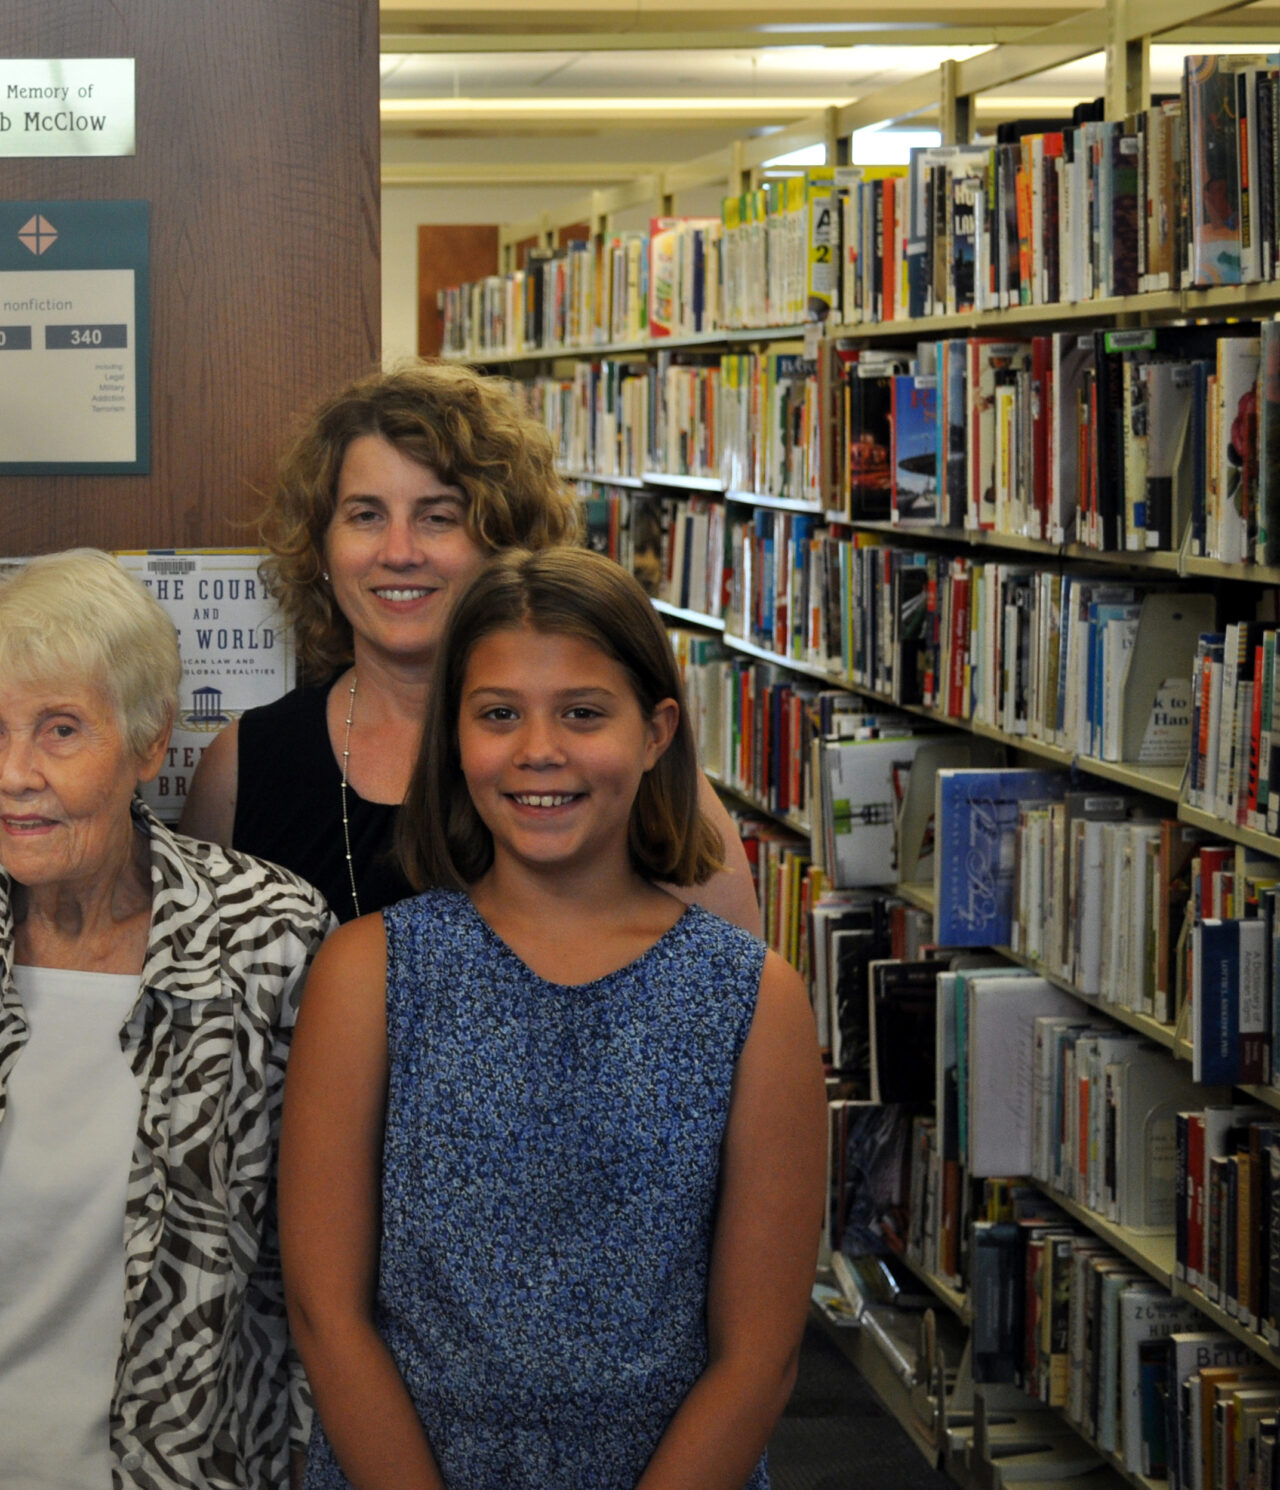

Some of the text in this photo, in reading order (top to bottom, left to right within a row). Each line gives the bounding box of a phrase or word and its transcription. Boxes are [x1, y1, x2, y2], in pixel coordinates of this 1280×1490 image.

[7, 84, 69, 100] Memory
[78, 84, 94, 99] of
[24, 112, 107, 132] McClow
[3, 298, 73, 312] nonfiction
[70, 329, 103, 346] 340
[105, 373, 125, 382] Legal
[99, 384, 125, 393] Military
[193, 608, 219, 620] AND
[196, 628, 274, 649] WORLD
[1171, 698, 1187, 709] to
[1154, 713, 1189, 726] Han
[158, 776, 187, 796] BR
